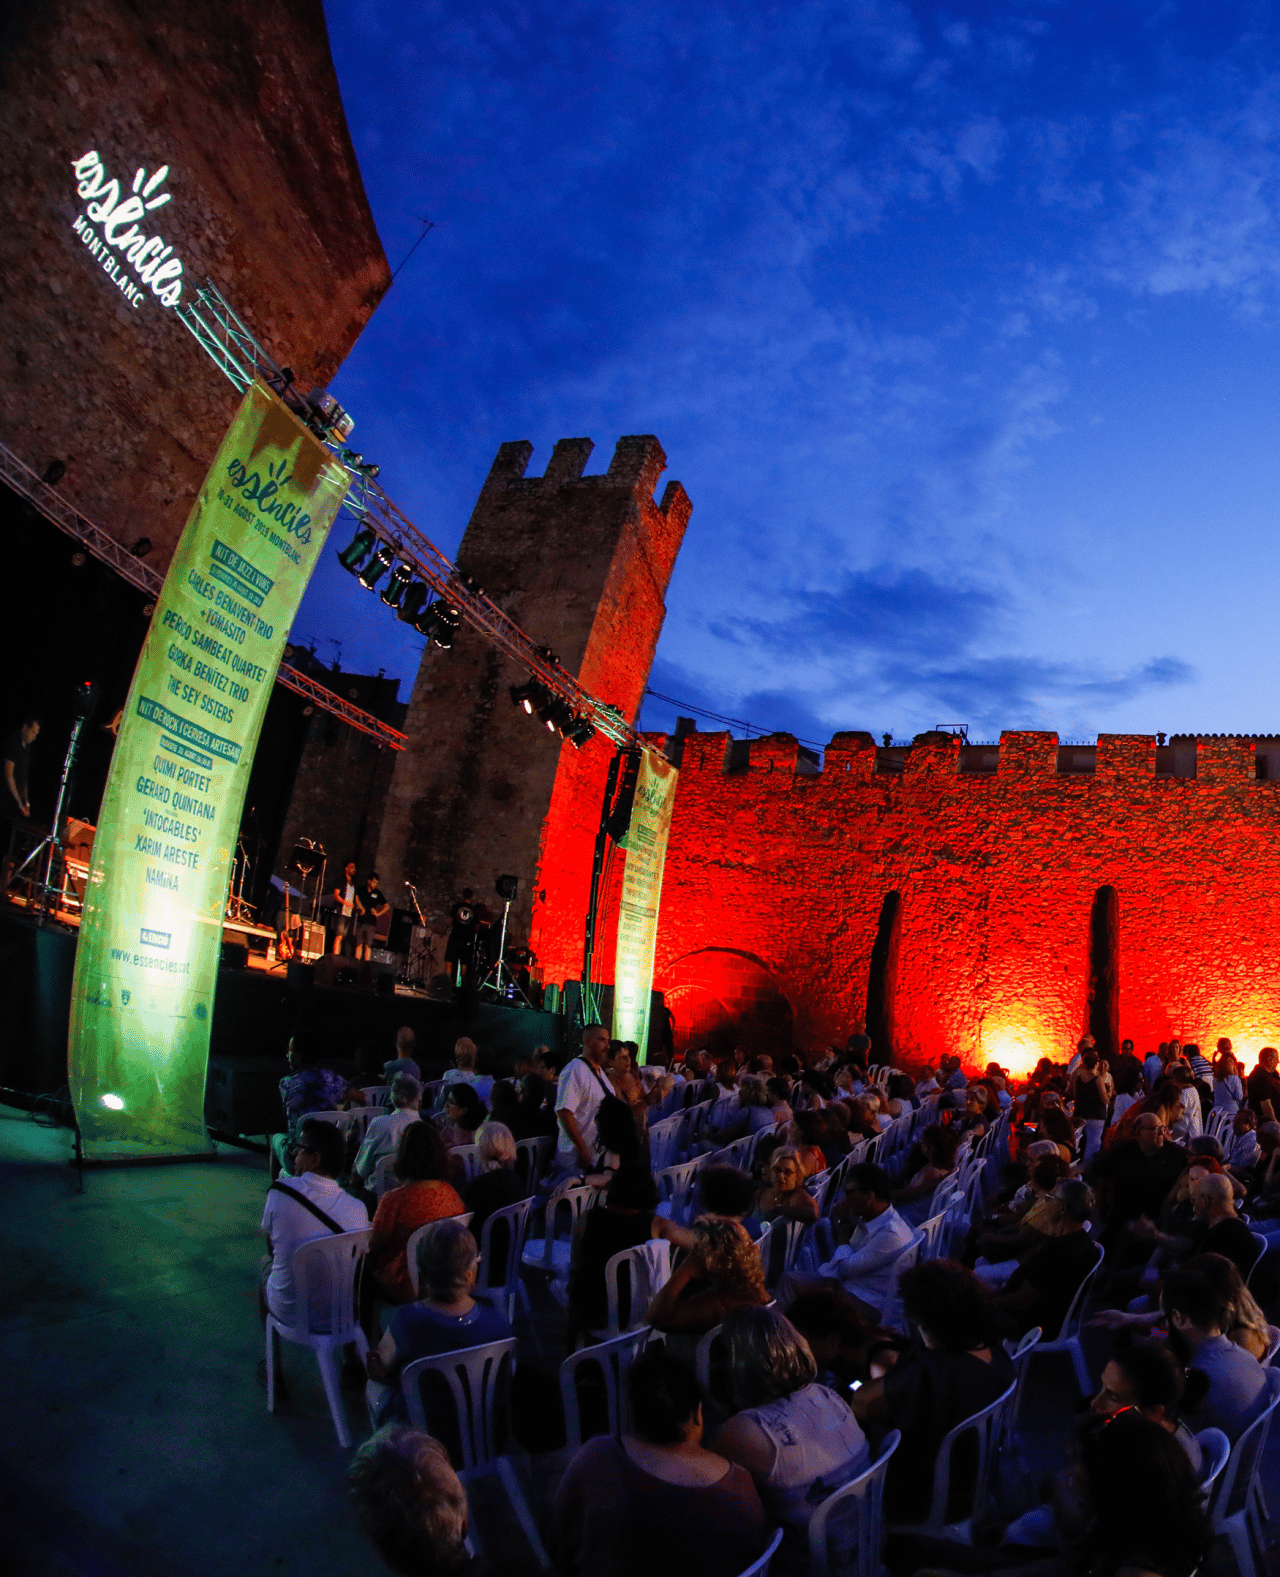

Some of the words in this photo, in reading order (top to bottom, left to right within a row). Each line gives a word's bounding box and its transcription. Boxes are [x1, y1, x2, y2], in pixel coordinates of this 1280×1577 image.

[72, 215, 145, 308] MONTBLANC
[188, 568, 215, 600] CARLES
[215, 590, 257, 628] BENAVENT
[254, 617, 274, 639] TRIO
[206, 607, 246, 645] TOMASITO
[191, 630, 233, 665] SAMBEAT
[231, 654, 267, 683] QUARTET
[139, 700, 153, 716] NIT
[153, 706, 162, 721] DE
[168, 674, 182, 696] THE
[182, 684, 201, 705] SEY
[200, 694, 234, 724] SISTERS
[228, 681, 249, 703] TRIO
[154, 755, 177, 779] QUIMI
[177, 766, 211, 793] PORTET
[136, 776, 170, 804] GERARD
[172, 792, 216, 821] QUINTANA
[134, 834, 162, 858] XARIM
